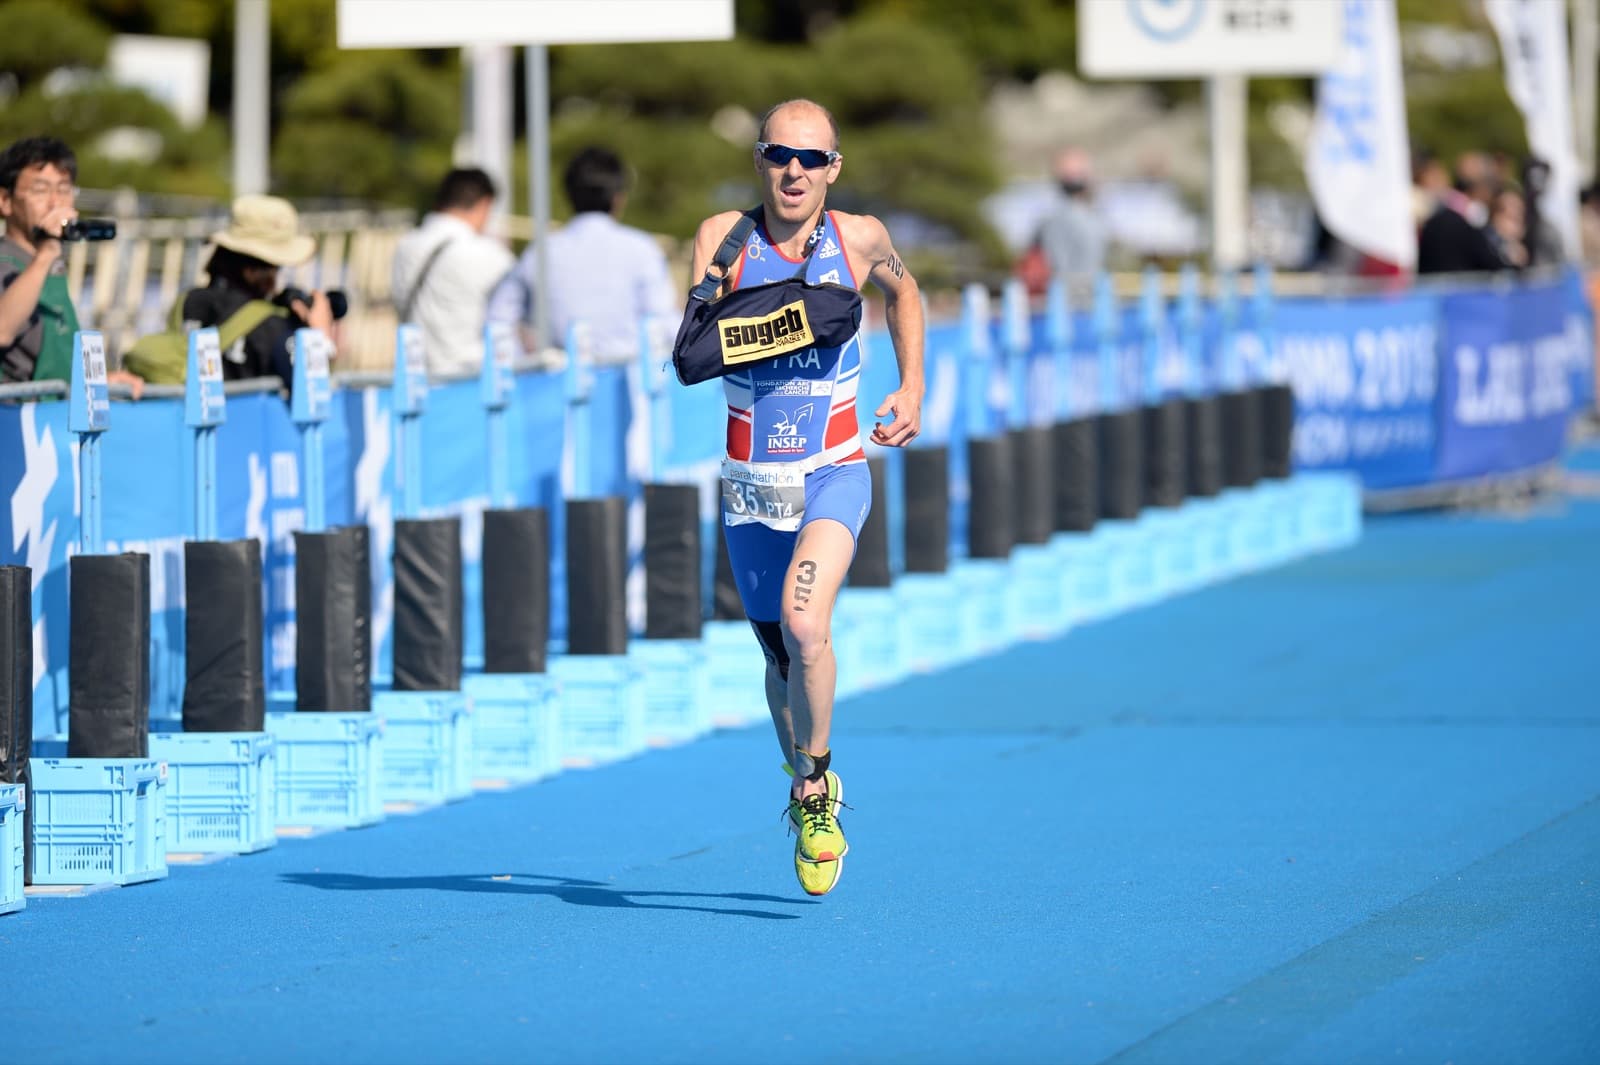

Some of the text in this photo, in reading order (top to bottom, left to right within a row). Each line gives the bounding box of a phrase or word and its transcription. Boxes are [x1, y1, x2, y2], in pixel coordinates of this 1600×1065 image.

[724, 308, 804, 348] sogeb
[767, 437, 808, 449] INSEP
[730, 469, 795, 484] paratriathlon
[732, 482, 794, 520] 35 PT4
